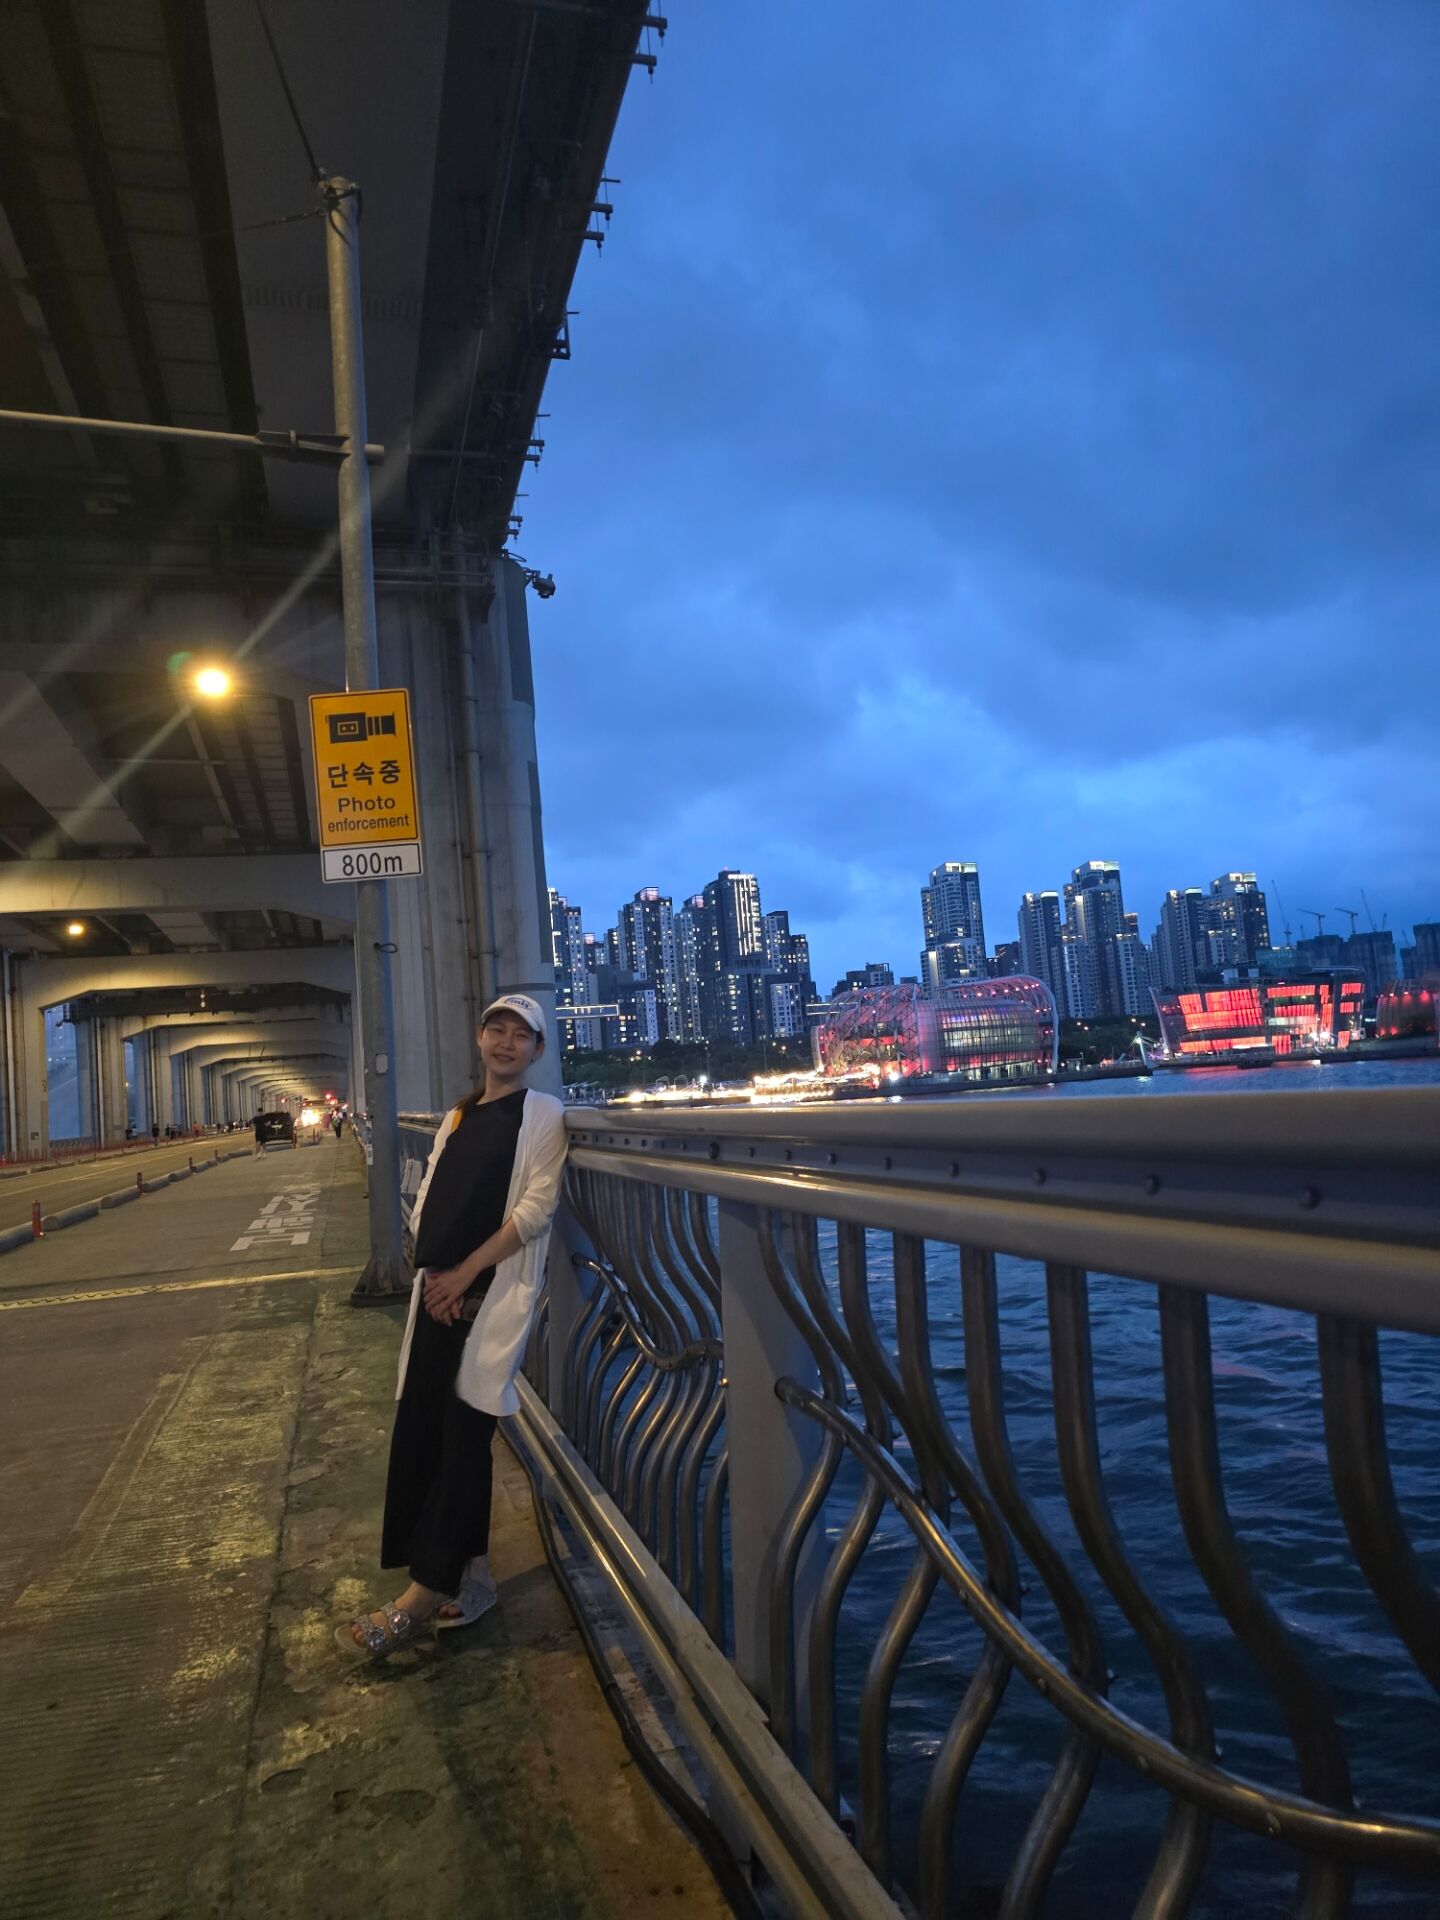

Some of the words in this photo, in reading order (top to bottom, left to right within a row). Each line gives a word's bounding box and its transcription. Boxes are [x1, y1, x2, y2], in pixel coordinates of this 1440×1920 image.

[327, 760, 401, 788] 단속중
[338, 796, 396, 813] Photo
[328, 813, 410, 833] enforcement
[342, 852, 403, 877] 800m
